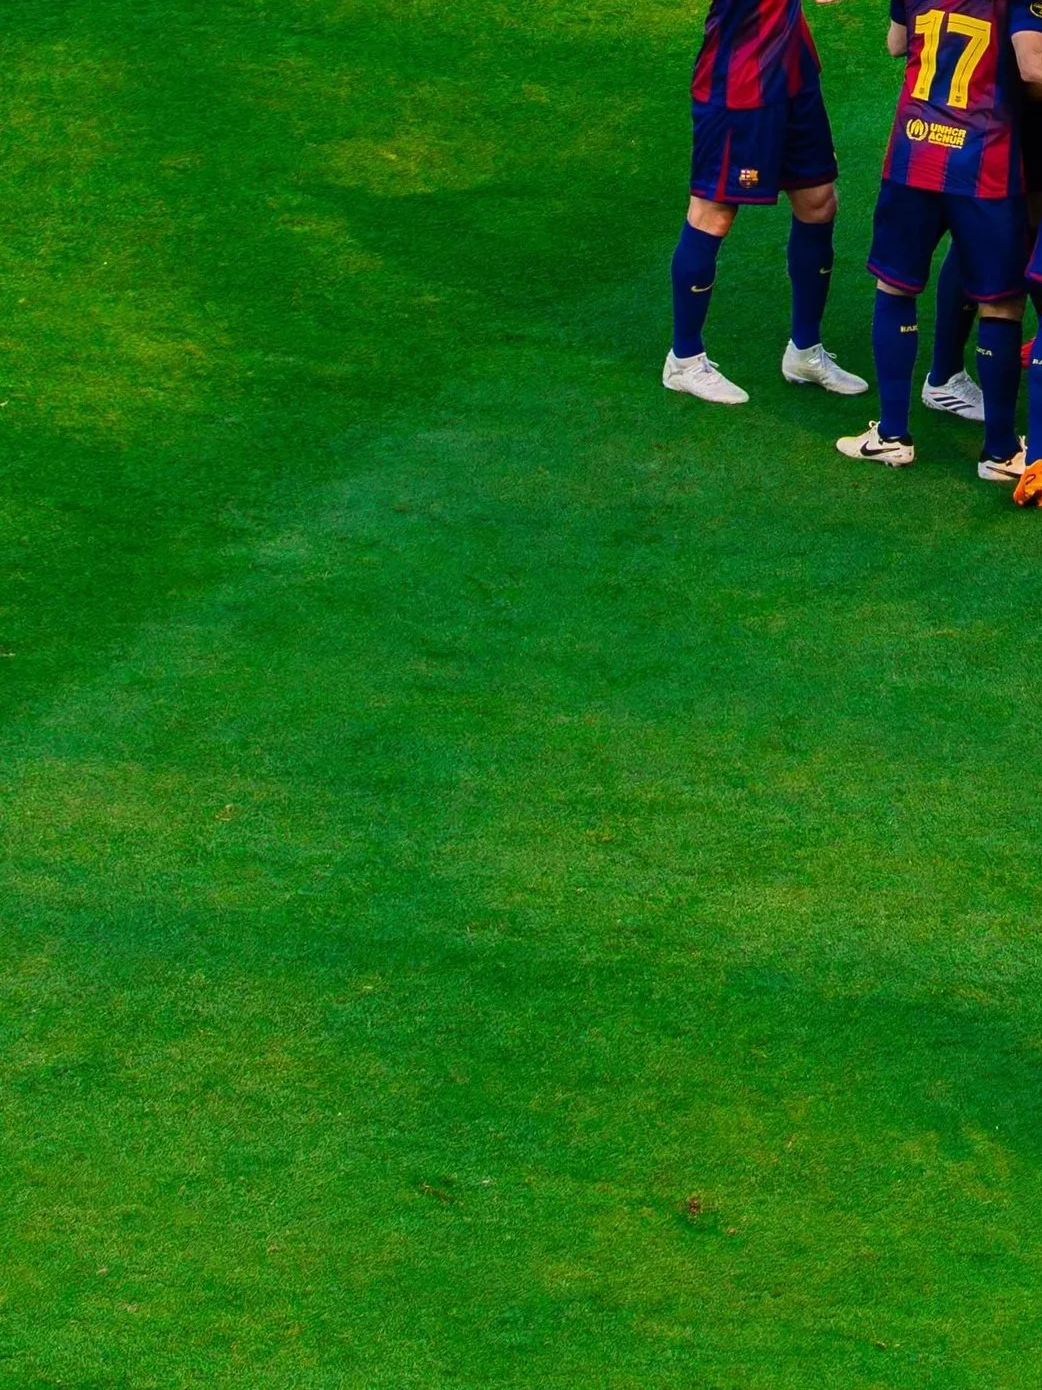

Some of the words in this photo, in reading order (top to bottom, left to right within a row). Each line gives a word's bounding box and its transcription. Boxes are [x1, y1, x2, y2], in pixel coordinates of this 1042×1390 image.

[911, 9, 992, 109] 17
[930, 123, 967, 138] UNHCR
[928, 131, 965, 146] ACNUR
